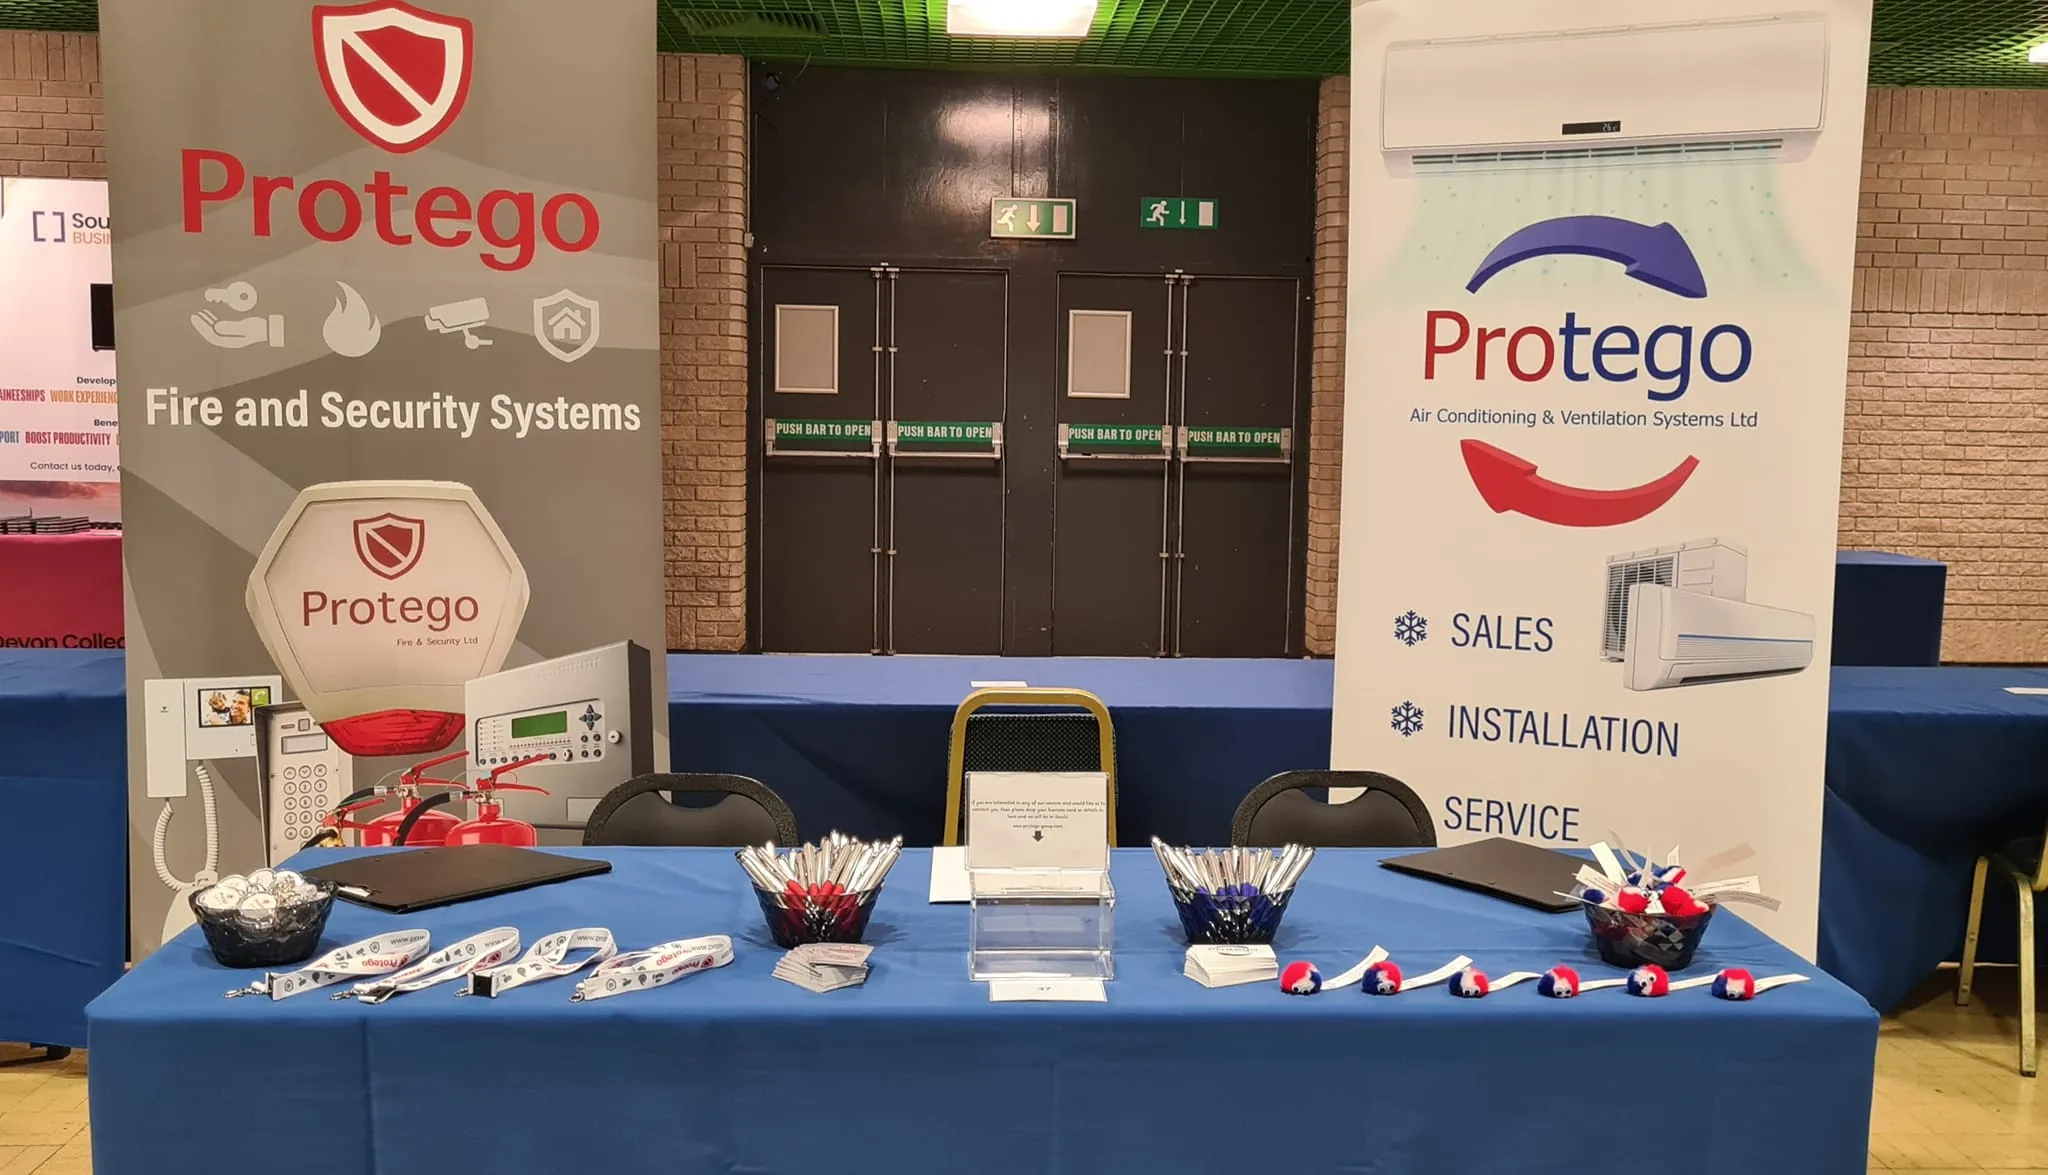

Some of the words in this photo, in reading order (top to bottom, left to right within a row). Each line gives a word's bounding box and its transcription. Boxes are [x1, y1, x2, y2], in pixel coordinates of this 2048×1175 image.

[181, 148, 600, 272] Protego
[72, 213, 110, 229] Sou
[1424, 310, 1752, 401] Protego
[76, 376, 117, 387] Develop
[50, 390, 74, 403] WORK
[146, 387, 224, 426] Fire
[235, 390, 308, 428] and
[320, 391, 480, 438] Security
[490, 395, 641, 438] Systems
[1410, 408, 1432, 423] Air
[1437, 408, 1537, 428] Conditioning
[1542, 410, 1555, 425] &
[1560, 410, 1647, 426] Ventilation
[1653, 412, 1724, 429] Systems
[1730, 412, 1758, 428] Ltd
[94, 419, 118, 427] Bene
[776, 422, 802, 435] PUSH
[805, 423, 826, 436] BAR
[828, 424, 841, 435] TO
[845, 424, 871, 436] OPEN
[25, 431, 51, 444] BOOST
[53, 432, 111, 446] PRODUCTIVITY
[898, 425, 924, 437] PUSH
[927, 426, 947, 437] BAR
[949, 426, 962, 438] TO
[966, 427, 992, 438] OPEN
[1068, 428, 1094, 440] PUSH
[1097, 428, 1117, 440] BAR
[1119, 429, 1132, 440] TO
[1136, 429, 1162, 441] OPEN
[1188, 430, 1213, 442] PUSH
[1216, 431, 1236, 443] BAR
[1239, 431, 1251, 443] TO
[1254, 431, 1281, 443] OPEN
[30, 462, 69, 471] Contact
[71, 463, 82, 471] us
[84, 463, 115, 473] today,
[303, 591, 479, 632] Protego
[1450, 612, 1554, 652] SALES
[0, 634, 58, 648] evon
[397, 638, 412, 647] Fire
[416, 638, 423, 646] &
[426, 637, 460, 647] Security
[464, 636, 479, 645] Ltd
[1449, 704, 1680, 757] INSTALLATION
[1444, 796, 1580, 842] SERVICE
